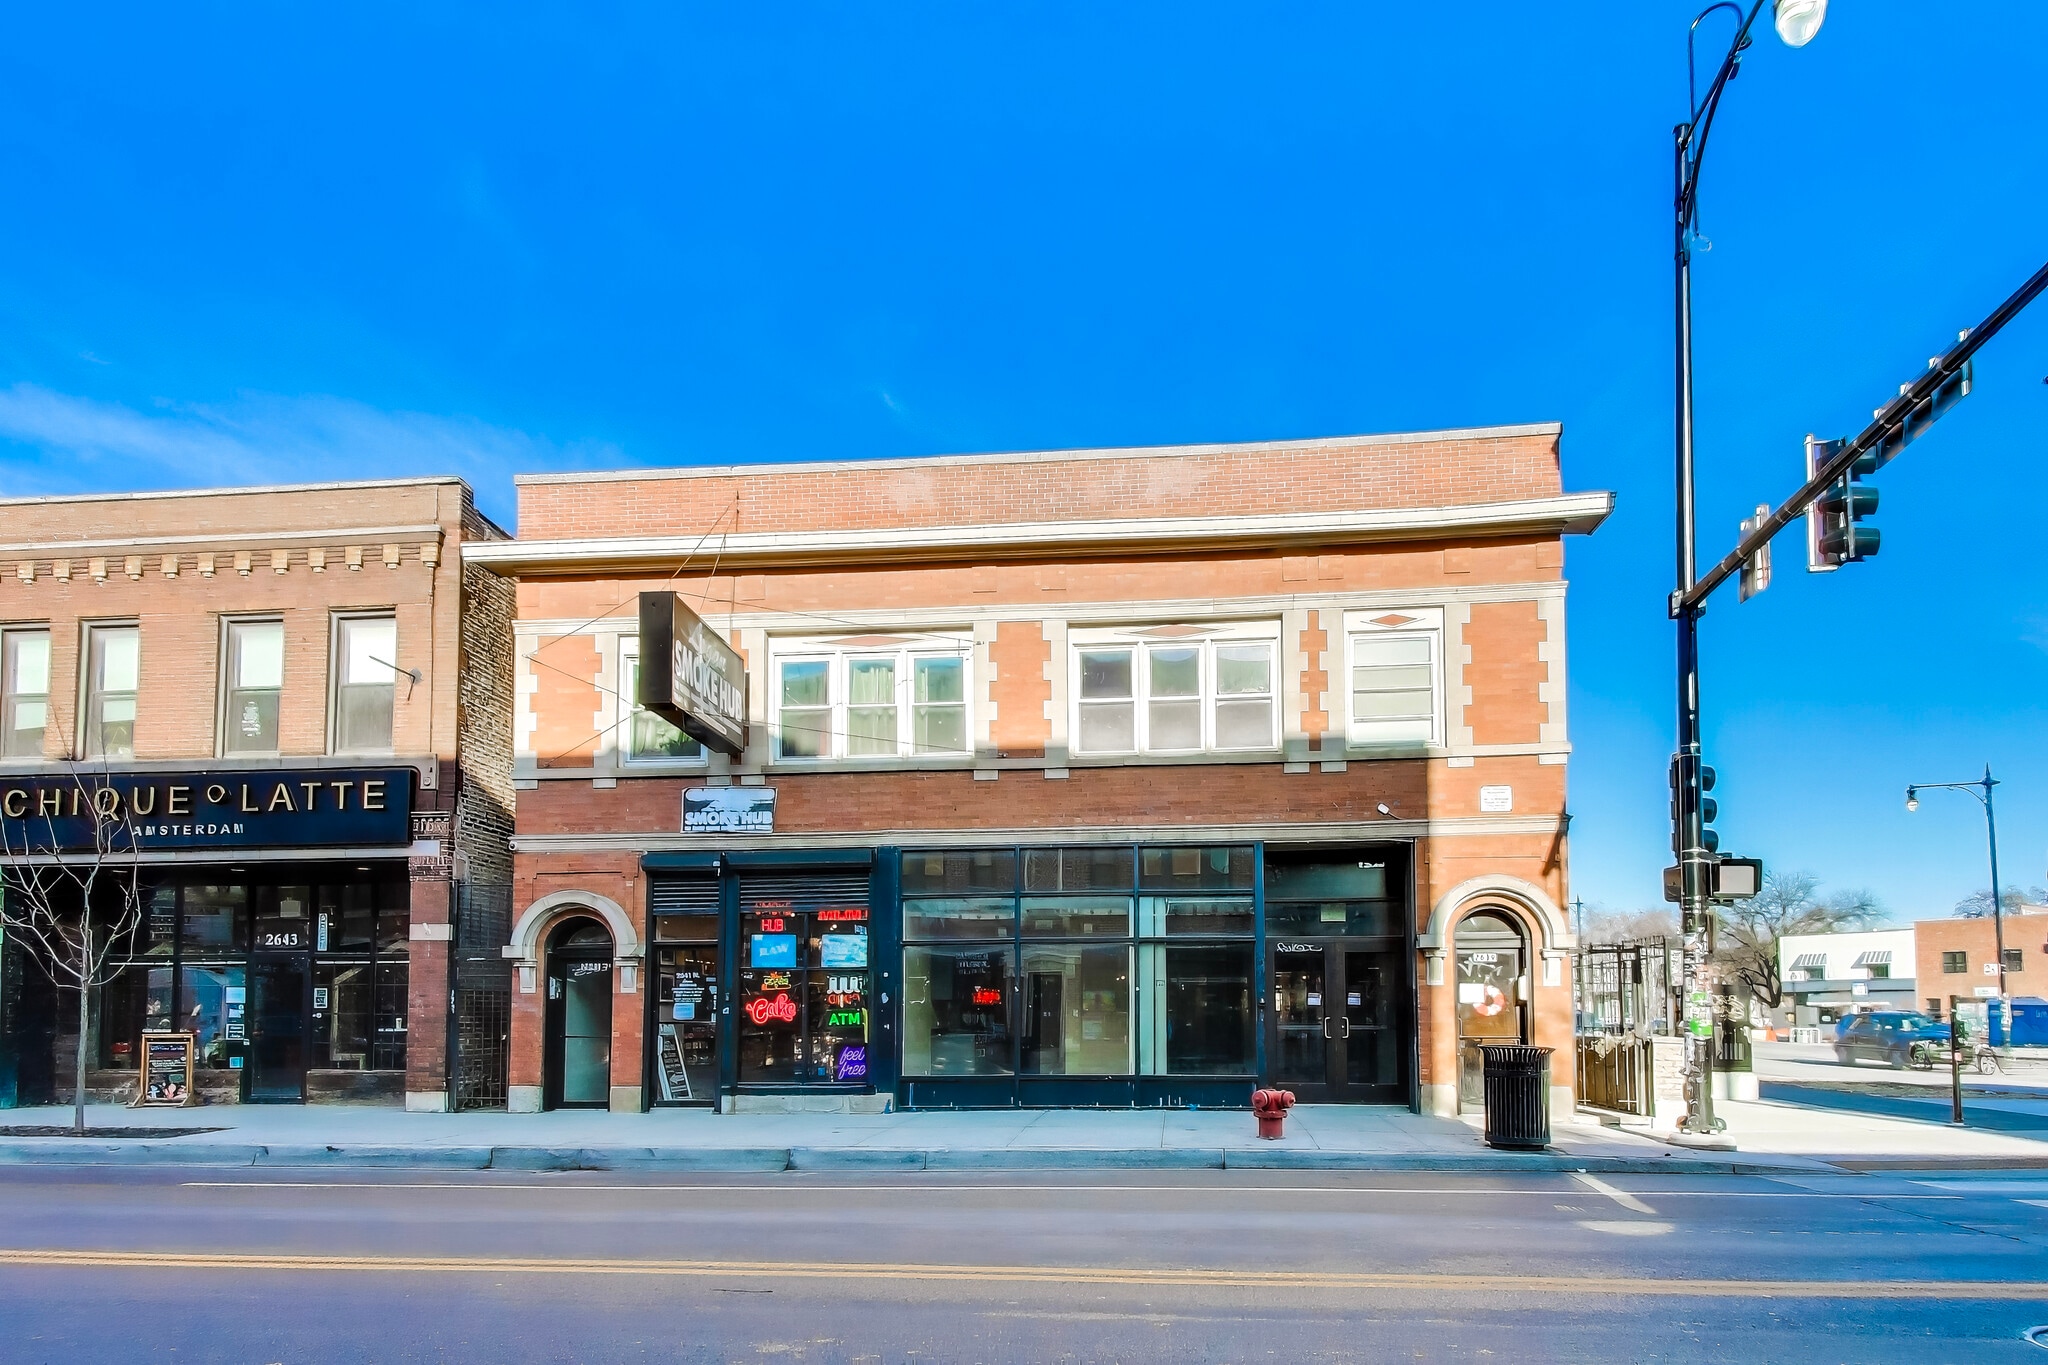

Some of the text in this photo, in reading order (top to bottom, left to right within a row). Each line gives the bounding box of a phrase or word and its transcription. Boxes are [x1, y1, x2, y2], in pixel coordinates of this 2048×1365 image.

[675, 640, 718, 706] SMOKE
[719, 676, 743, 723] HUB
[3, 786, 191, 821] CHIQUE
[242, 781, 385, 812] LATTE
[684, 811, 773, 825] SMOKE HUB
[133, 823, 244, 837] AMSTERDAM
[761, 918, 784, 932] HUB
[265, 933, 298, 946] 2643
[759, 943, 789, 957] RAW
[746, 993, 797, 1024] Cake
[829, 1012, 861, 1026] ATM
[839, 1046, 865, 1064] feel
[838, 1063, 866, 1080] free
